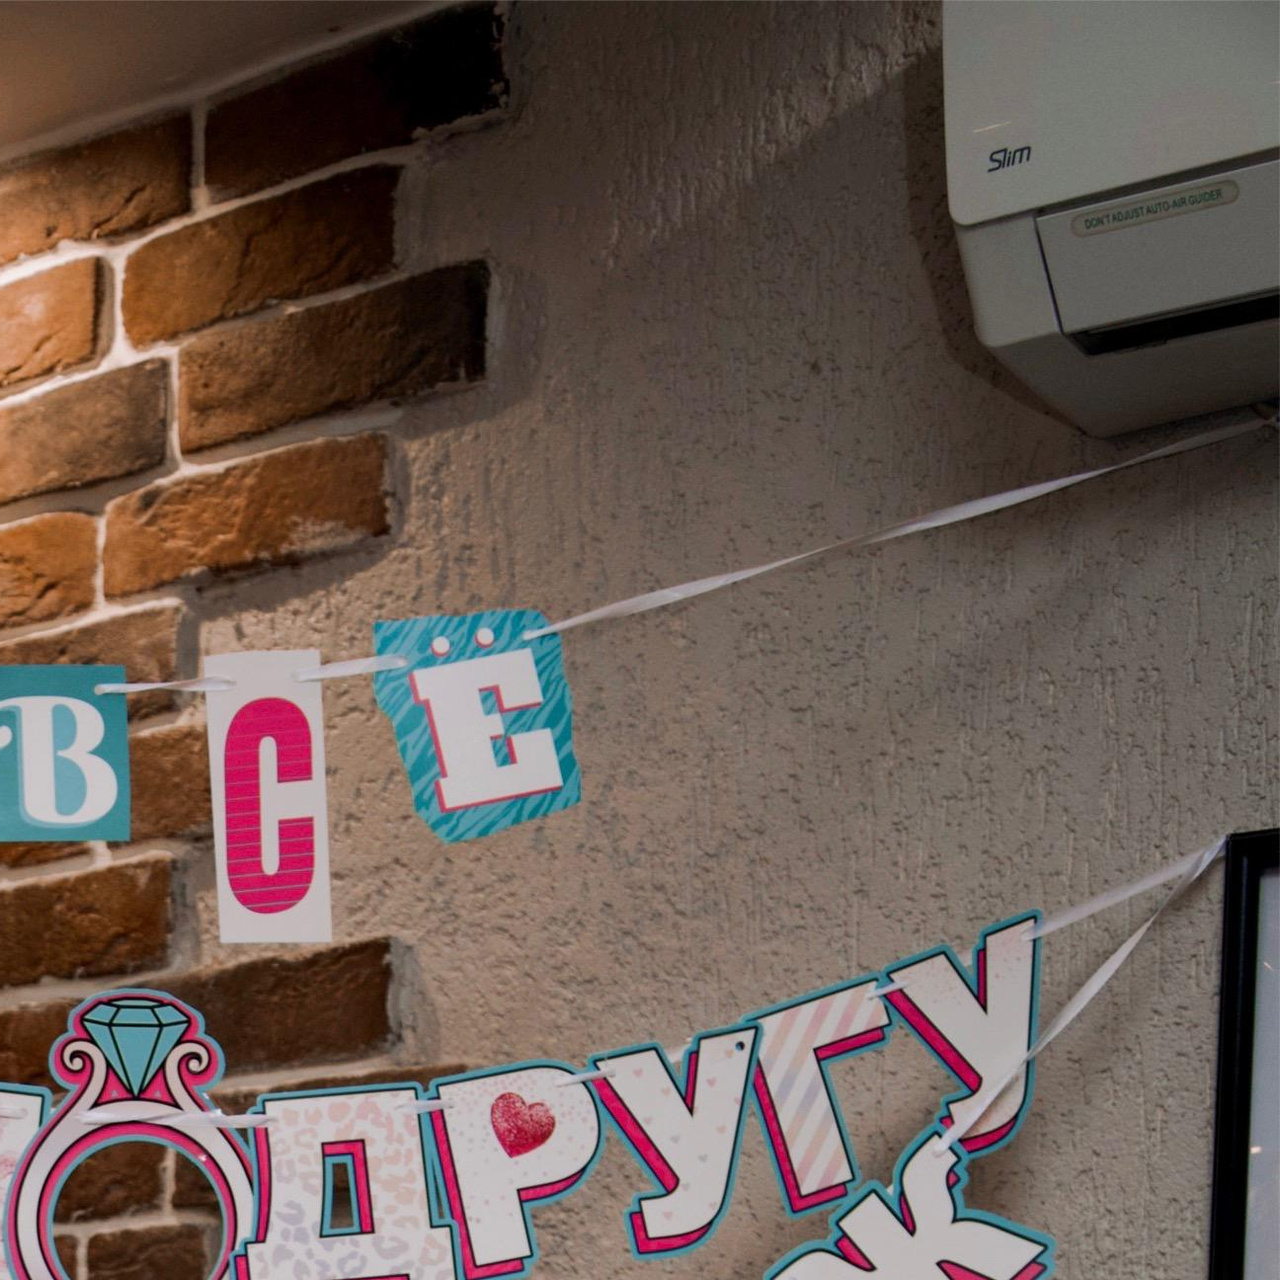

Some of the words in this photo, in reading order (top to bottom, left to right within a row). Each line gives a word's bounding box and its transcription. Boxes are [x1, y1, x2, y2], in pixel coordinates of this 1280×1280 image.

[987, 145, 1032, 173] Slim
[1111, 206, 1147, 223] ADJUST
[1187, 187, 1224, 206] GUIDER
